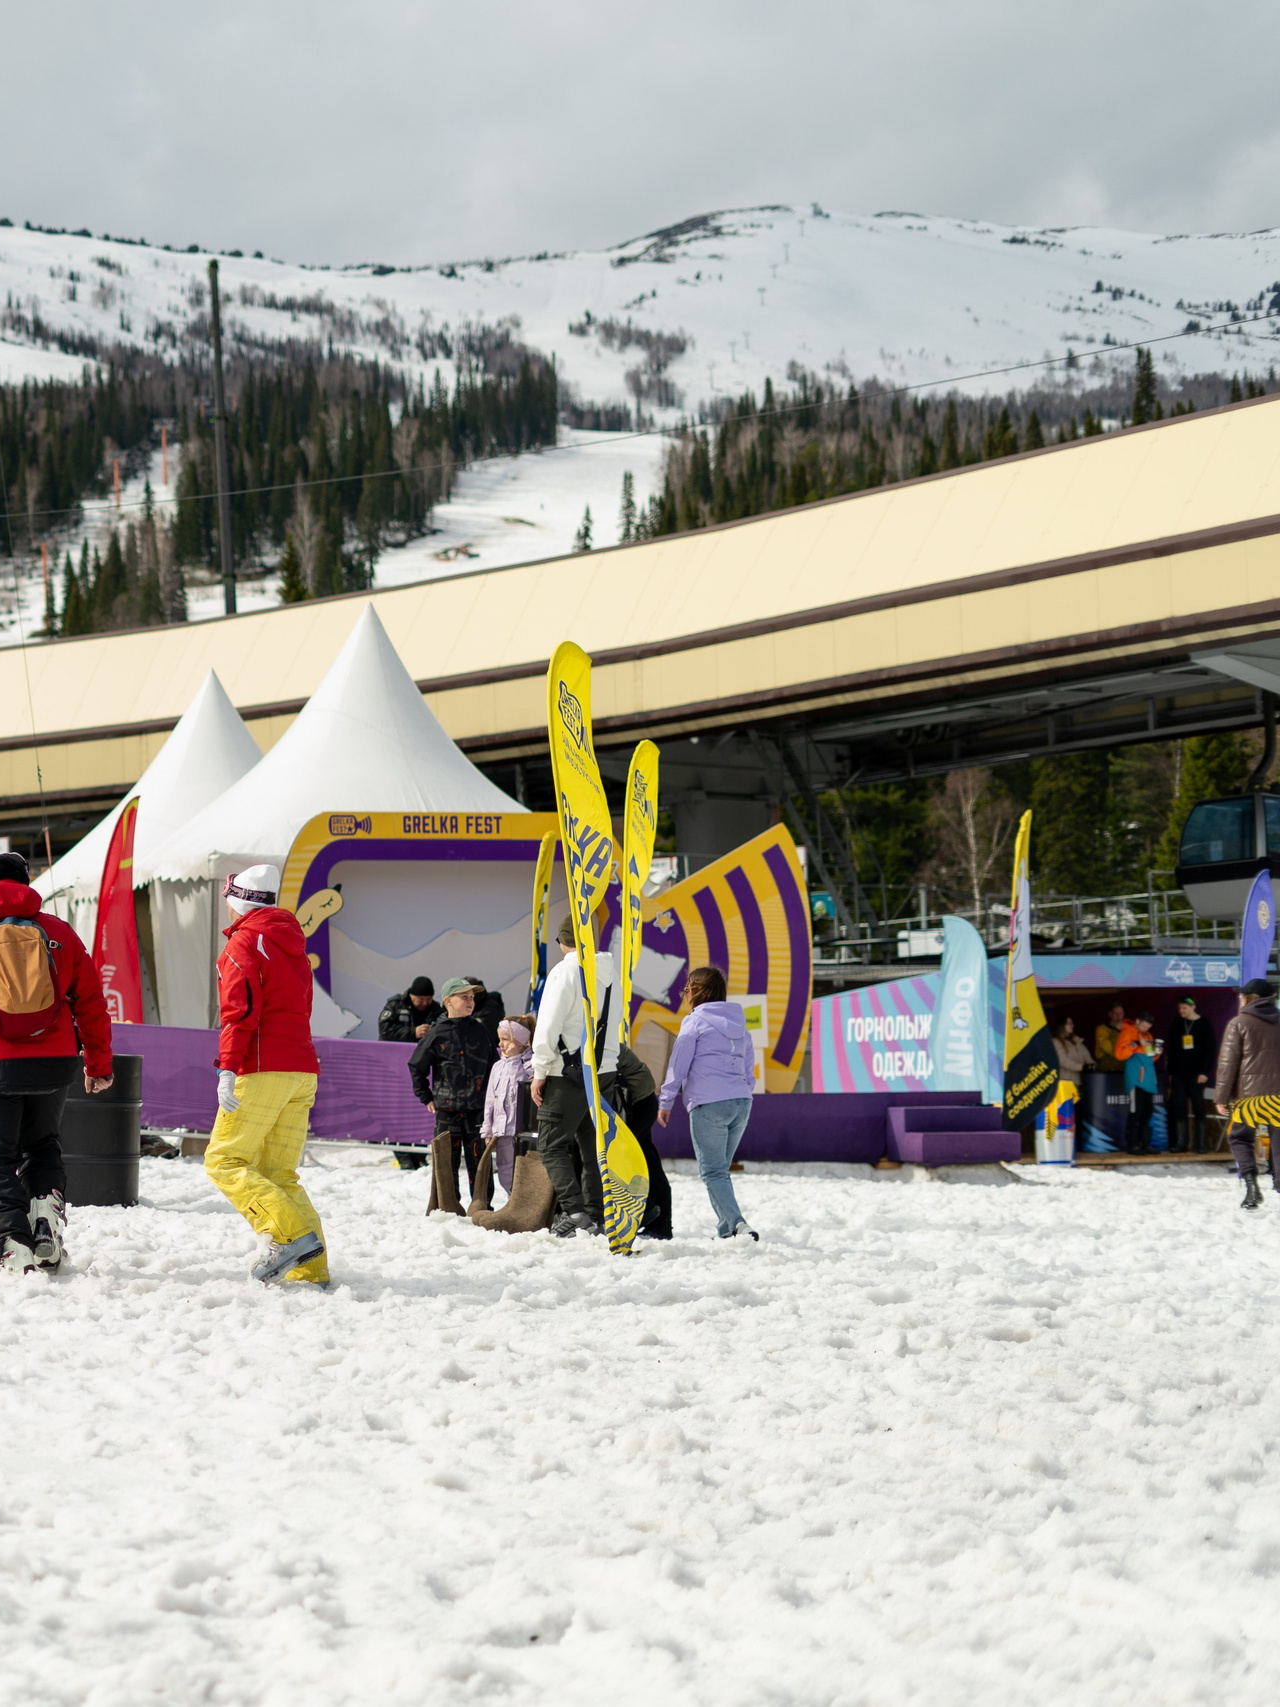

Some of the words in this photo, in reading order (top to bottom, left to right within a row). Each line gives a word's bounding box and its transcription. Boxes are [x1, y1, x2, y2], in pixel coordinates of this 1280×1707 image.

[402, 815, 459, 834] GRELKA
[466, 816, 502, 834] FEST
[1008, 1069, 1058, 1119] соединяет
